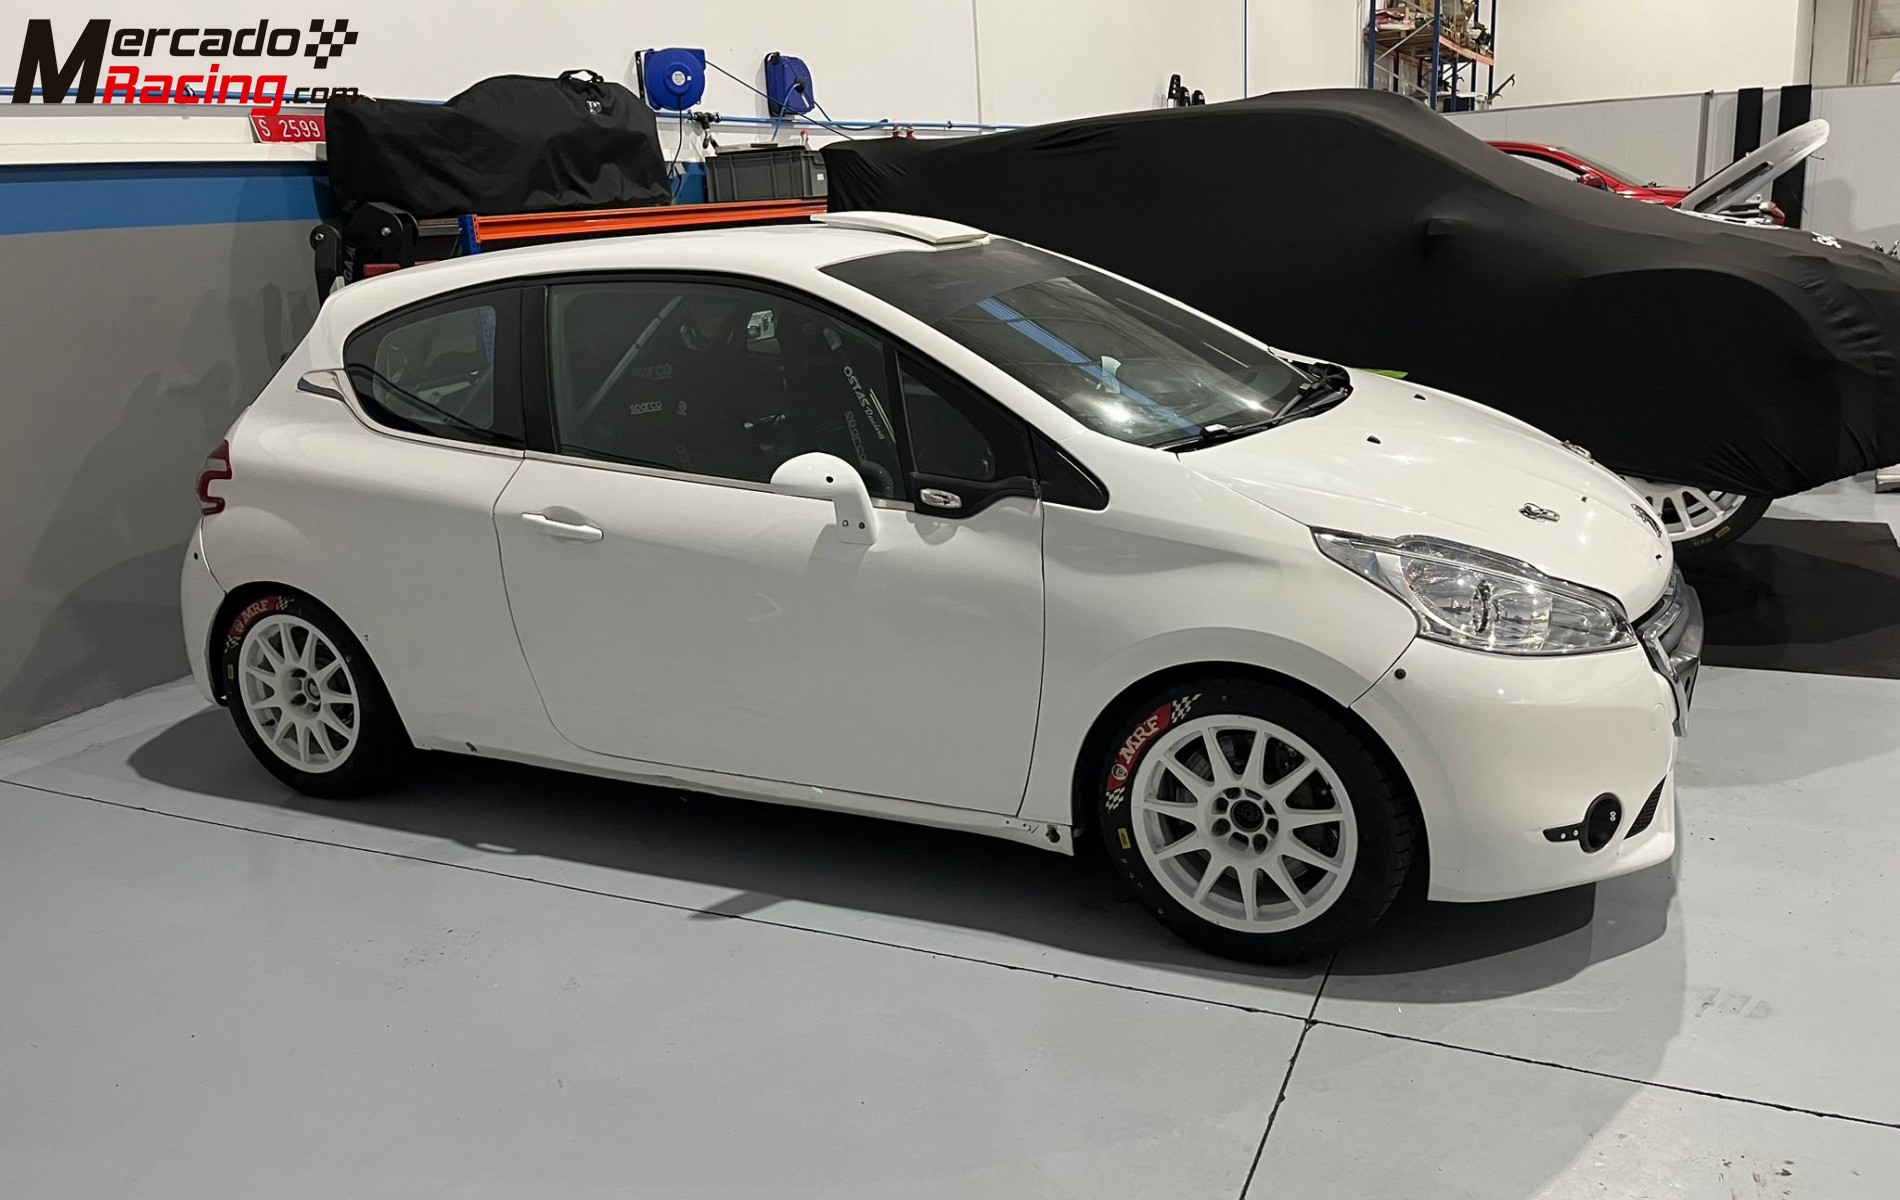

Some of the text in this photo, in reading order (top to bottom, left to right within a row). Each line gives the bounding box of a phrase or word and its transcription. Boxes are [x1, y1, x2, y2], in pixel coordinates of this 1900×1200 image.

[259, 119, 321, 138] S 2599
[843, 365, 871, 409] OSTAS
[630, 400, 662, 414] sparco
[241, 600, 269, 623] MRF
[1119, 715, 1159, 764] MRF
